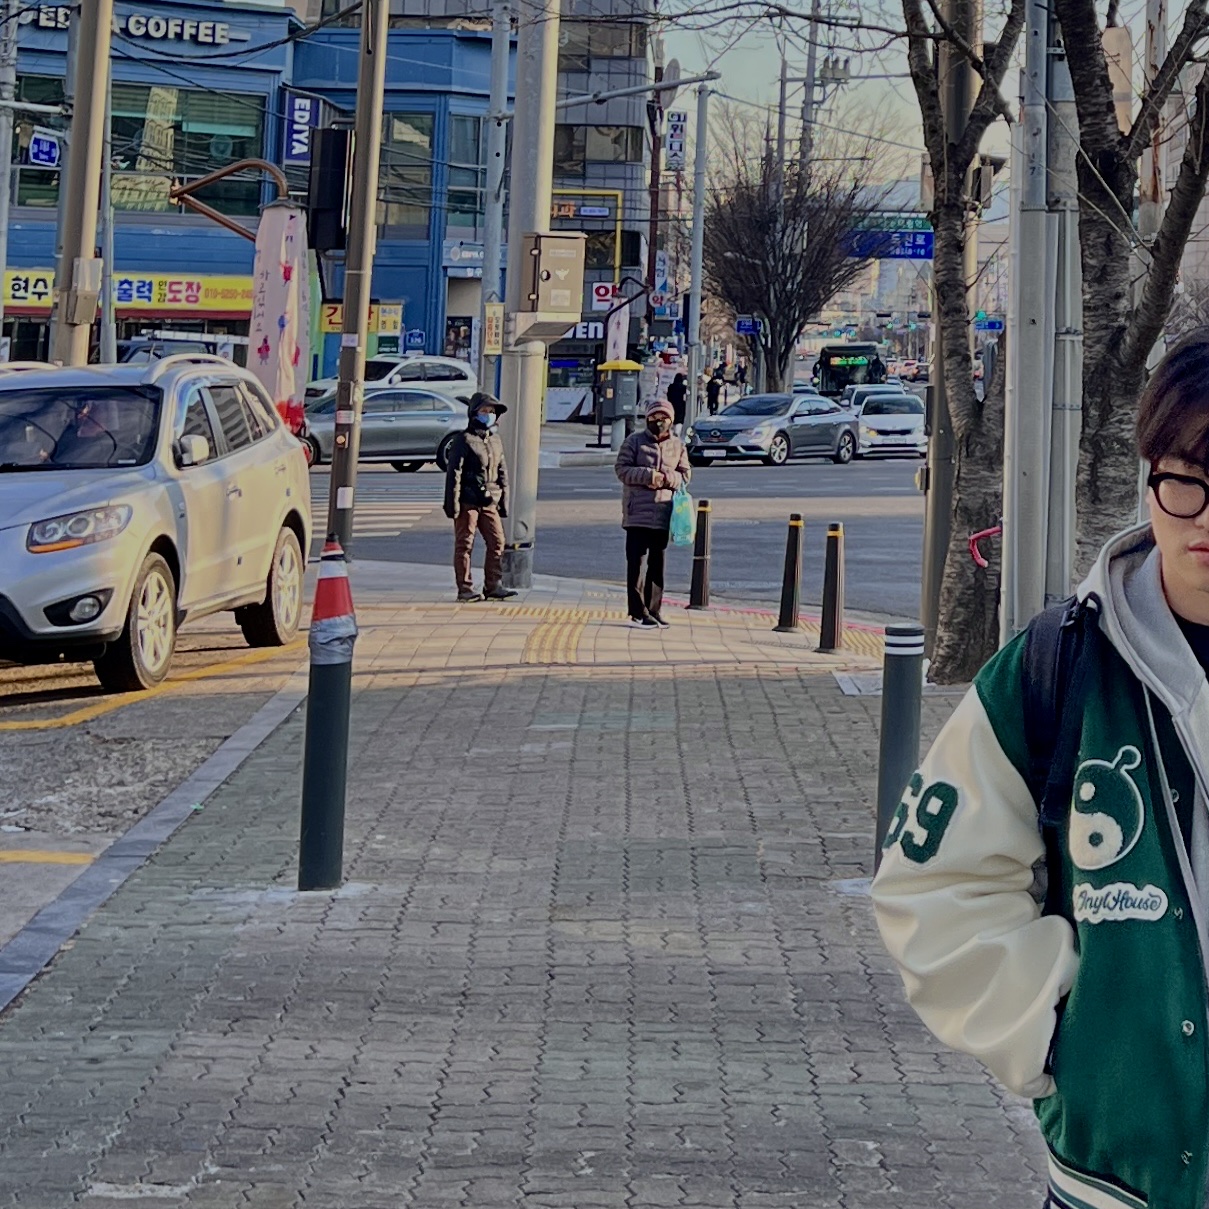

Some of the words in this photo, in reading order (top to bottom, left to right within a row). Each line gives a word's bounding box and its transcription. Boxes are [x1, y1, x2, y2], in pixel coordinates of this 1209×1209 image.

[128, 14, 230, 44] COFFEE
[291, 97, 311, 155] EDIYA
[11, 276, 49, 301] 현수
[168, 280, 202, 304] 도장
